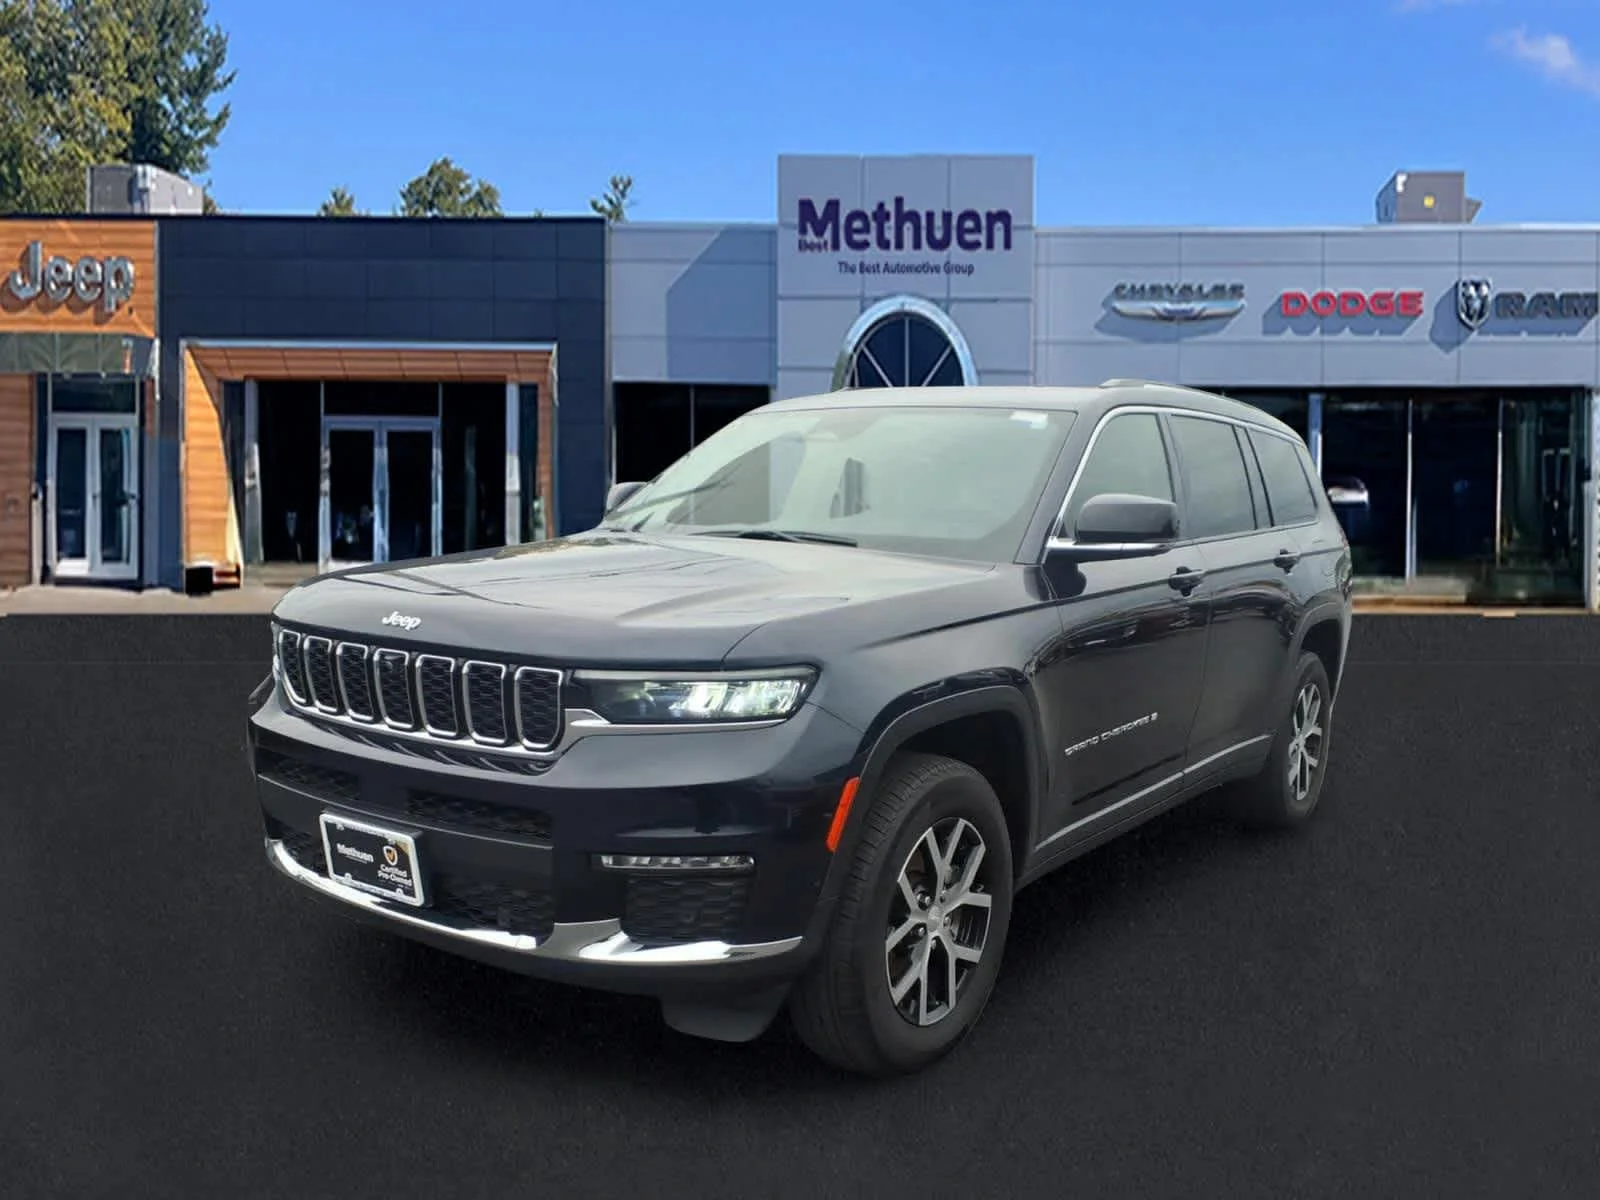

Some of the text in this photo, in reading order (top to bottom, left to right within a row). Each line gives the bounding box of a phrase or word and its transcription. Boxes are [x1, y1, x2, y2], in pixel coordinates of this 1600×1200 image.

[798, 196, 1012, 252] Methuen
[798, 239, 829, 252] Best
[9, 240, 135, 314] Jeep
[838, 260, 975, 277] The Best Automotive Group
[1281, 291, 1424, 317] DODGE
[1495, 291, 1598, 319] RAM
[381, 610, 421, 631] Jeep
[336, 843, 373, 862] Methuen
